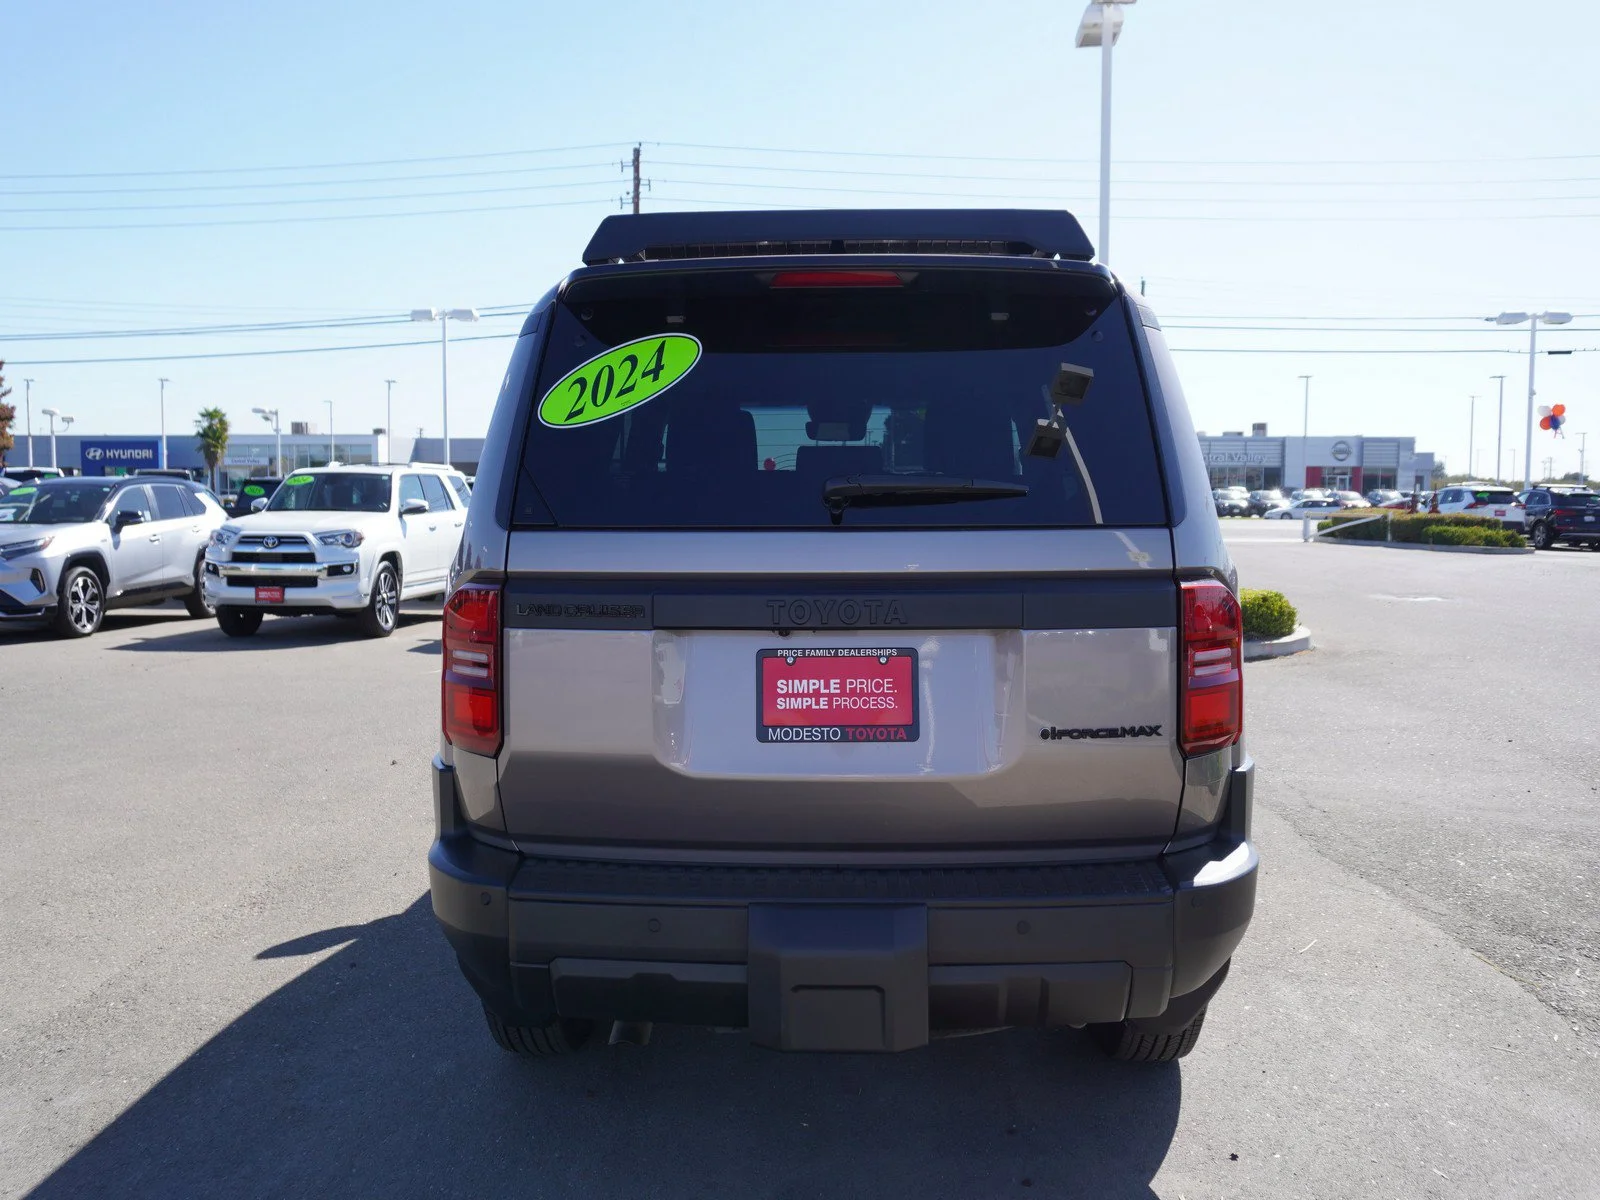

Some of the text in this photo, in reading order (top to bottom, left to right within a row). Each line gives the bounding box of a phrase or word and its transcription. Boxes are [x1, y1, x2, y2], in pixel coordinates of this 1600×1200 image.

[564, 339, 667, 422] 2024
[106, 449, 153, 459] HYUNDAI
[516, 603, 645, 618] LAND CRUISER
[766, 599, 908, 625] TOYOTA
[777, 648, 898, 657] PRICE FAMILY DEALERSHIPS
[776, 678, 898, 694] SIMPLE PRICE.
[776, 697, 898, 710] SIMPLE PROCESS.
[768, 727, 907, 741] MODESTO TOYOTA
